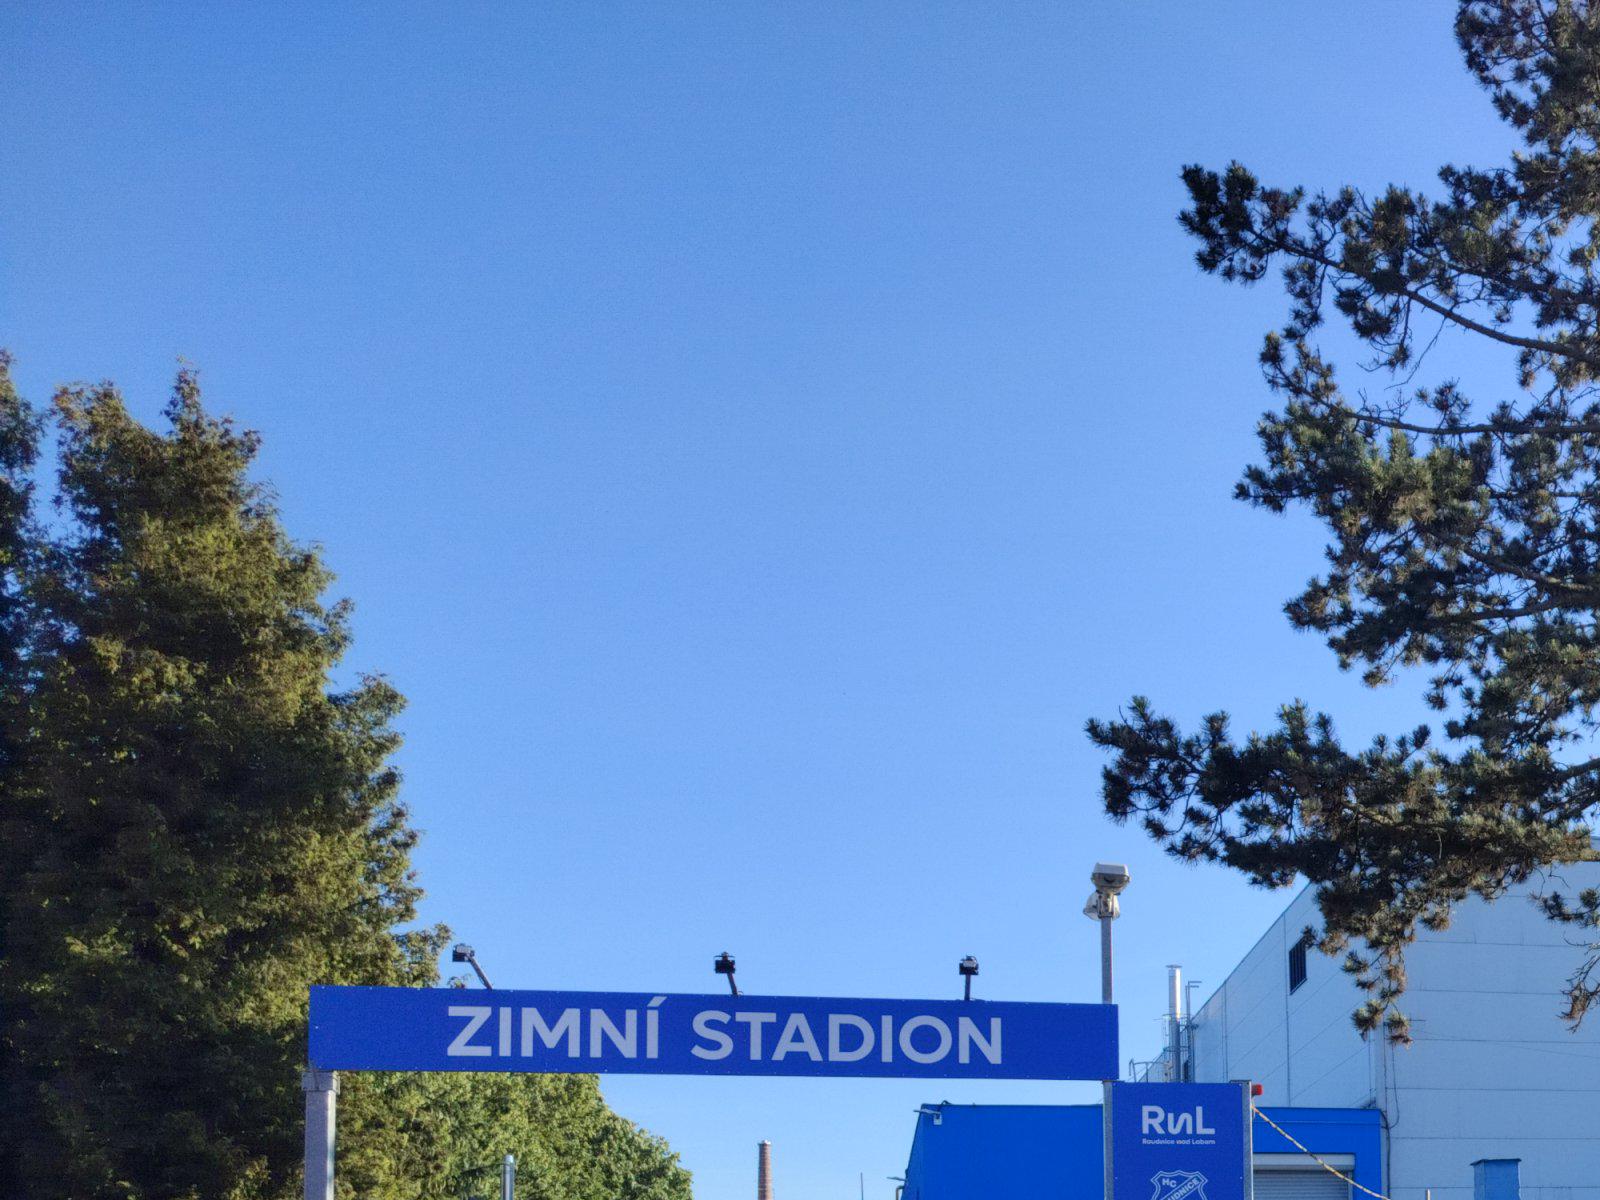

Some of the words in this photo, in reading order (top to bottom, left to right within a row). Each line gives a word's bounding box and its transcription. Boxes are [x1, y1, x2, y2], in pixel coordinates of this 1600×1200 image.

[447, 996, 667, 1059] ZIMNÍ
[691, 1010, 1002, 1064] STADION
[1162, 1178, 1177, 1188] HC
